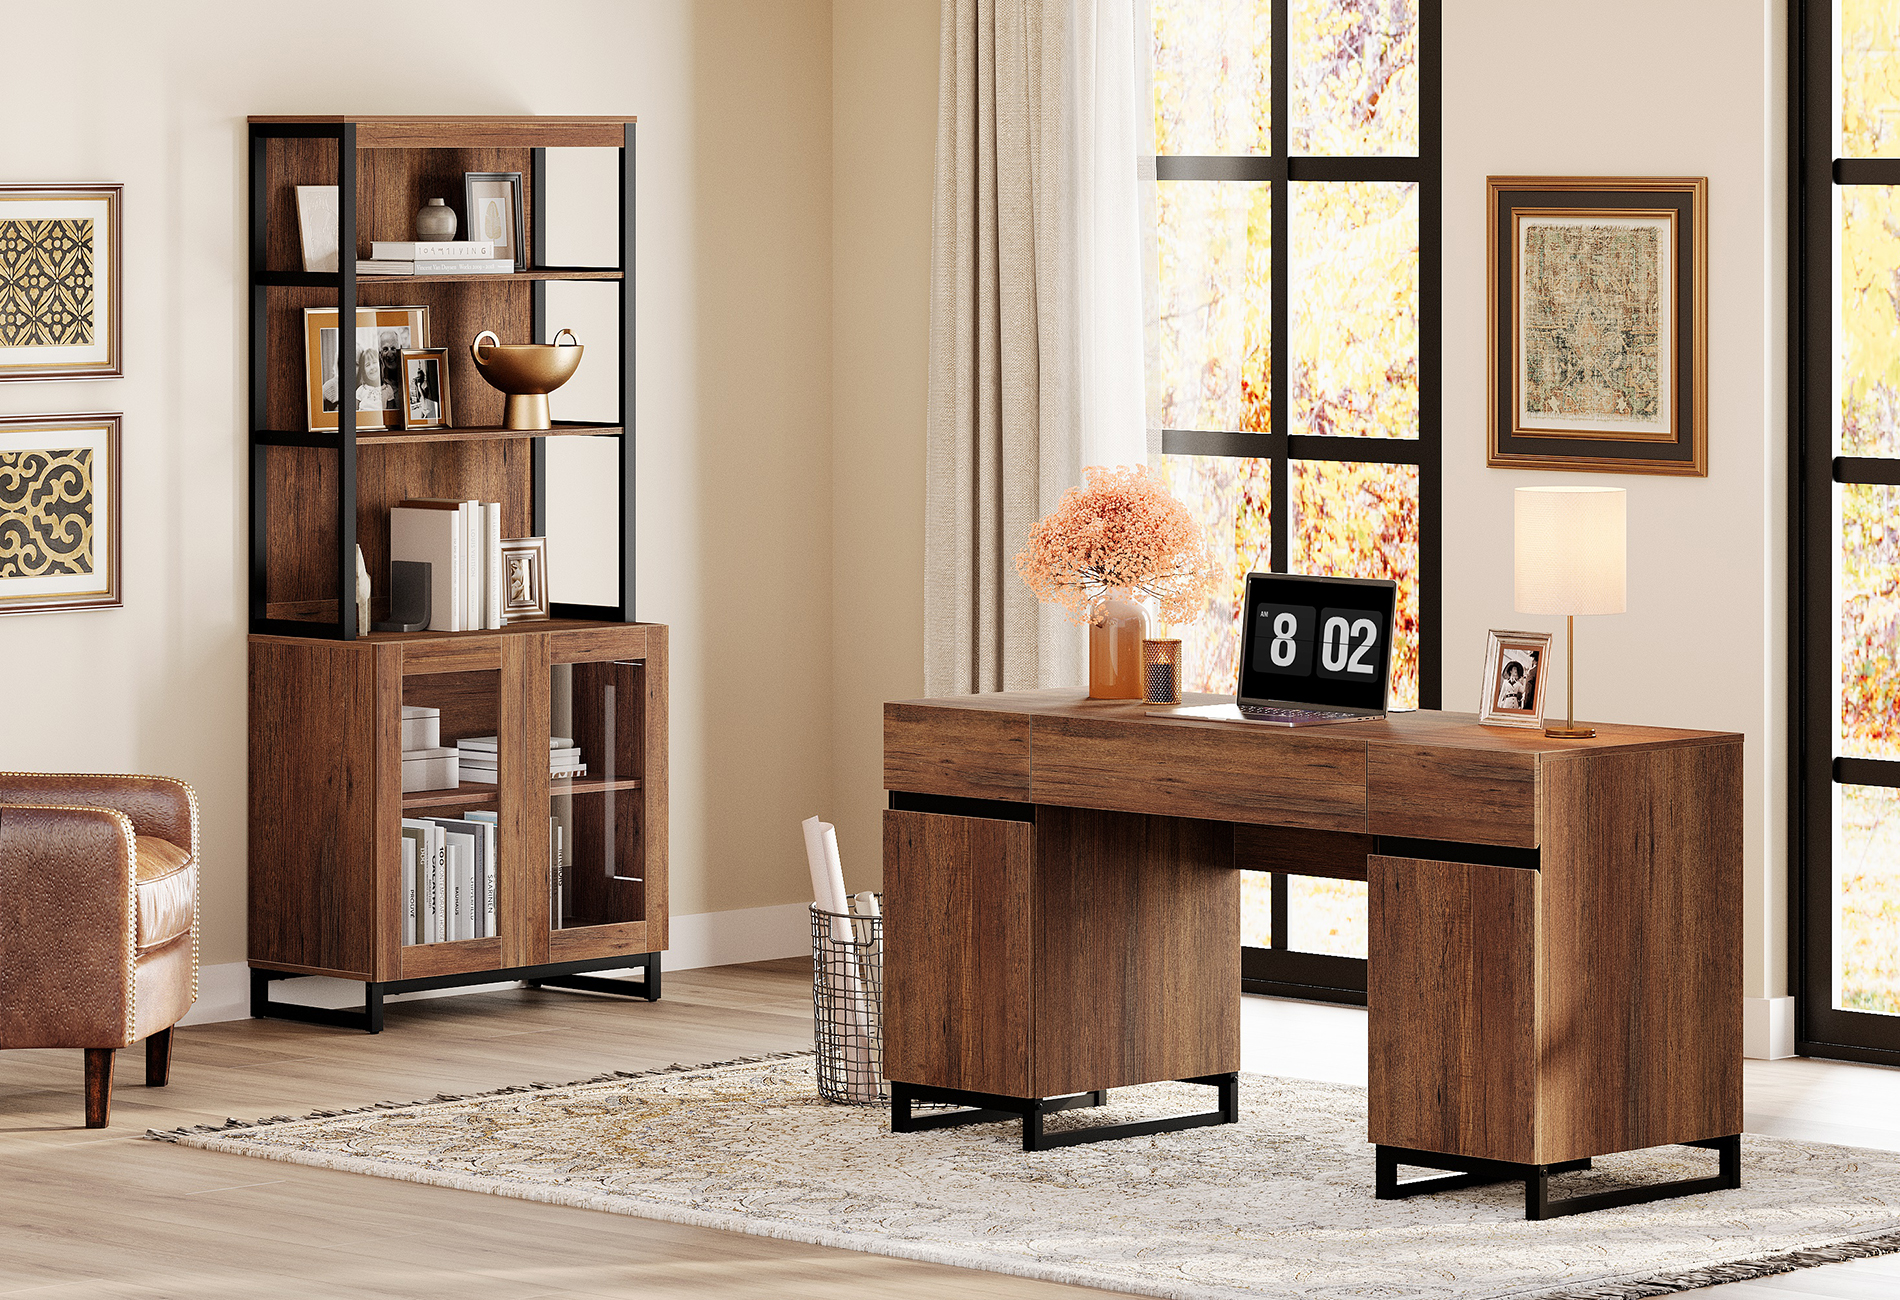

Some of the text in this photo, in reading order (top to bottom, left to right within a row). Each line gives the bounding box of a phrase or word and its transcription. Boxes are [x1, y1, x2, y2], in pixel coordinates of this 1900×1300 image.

[1260, 610, 1269, 618] AM
[1270, 612, 1378, 675] 8 02
